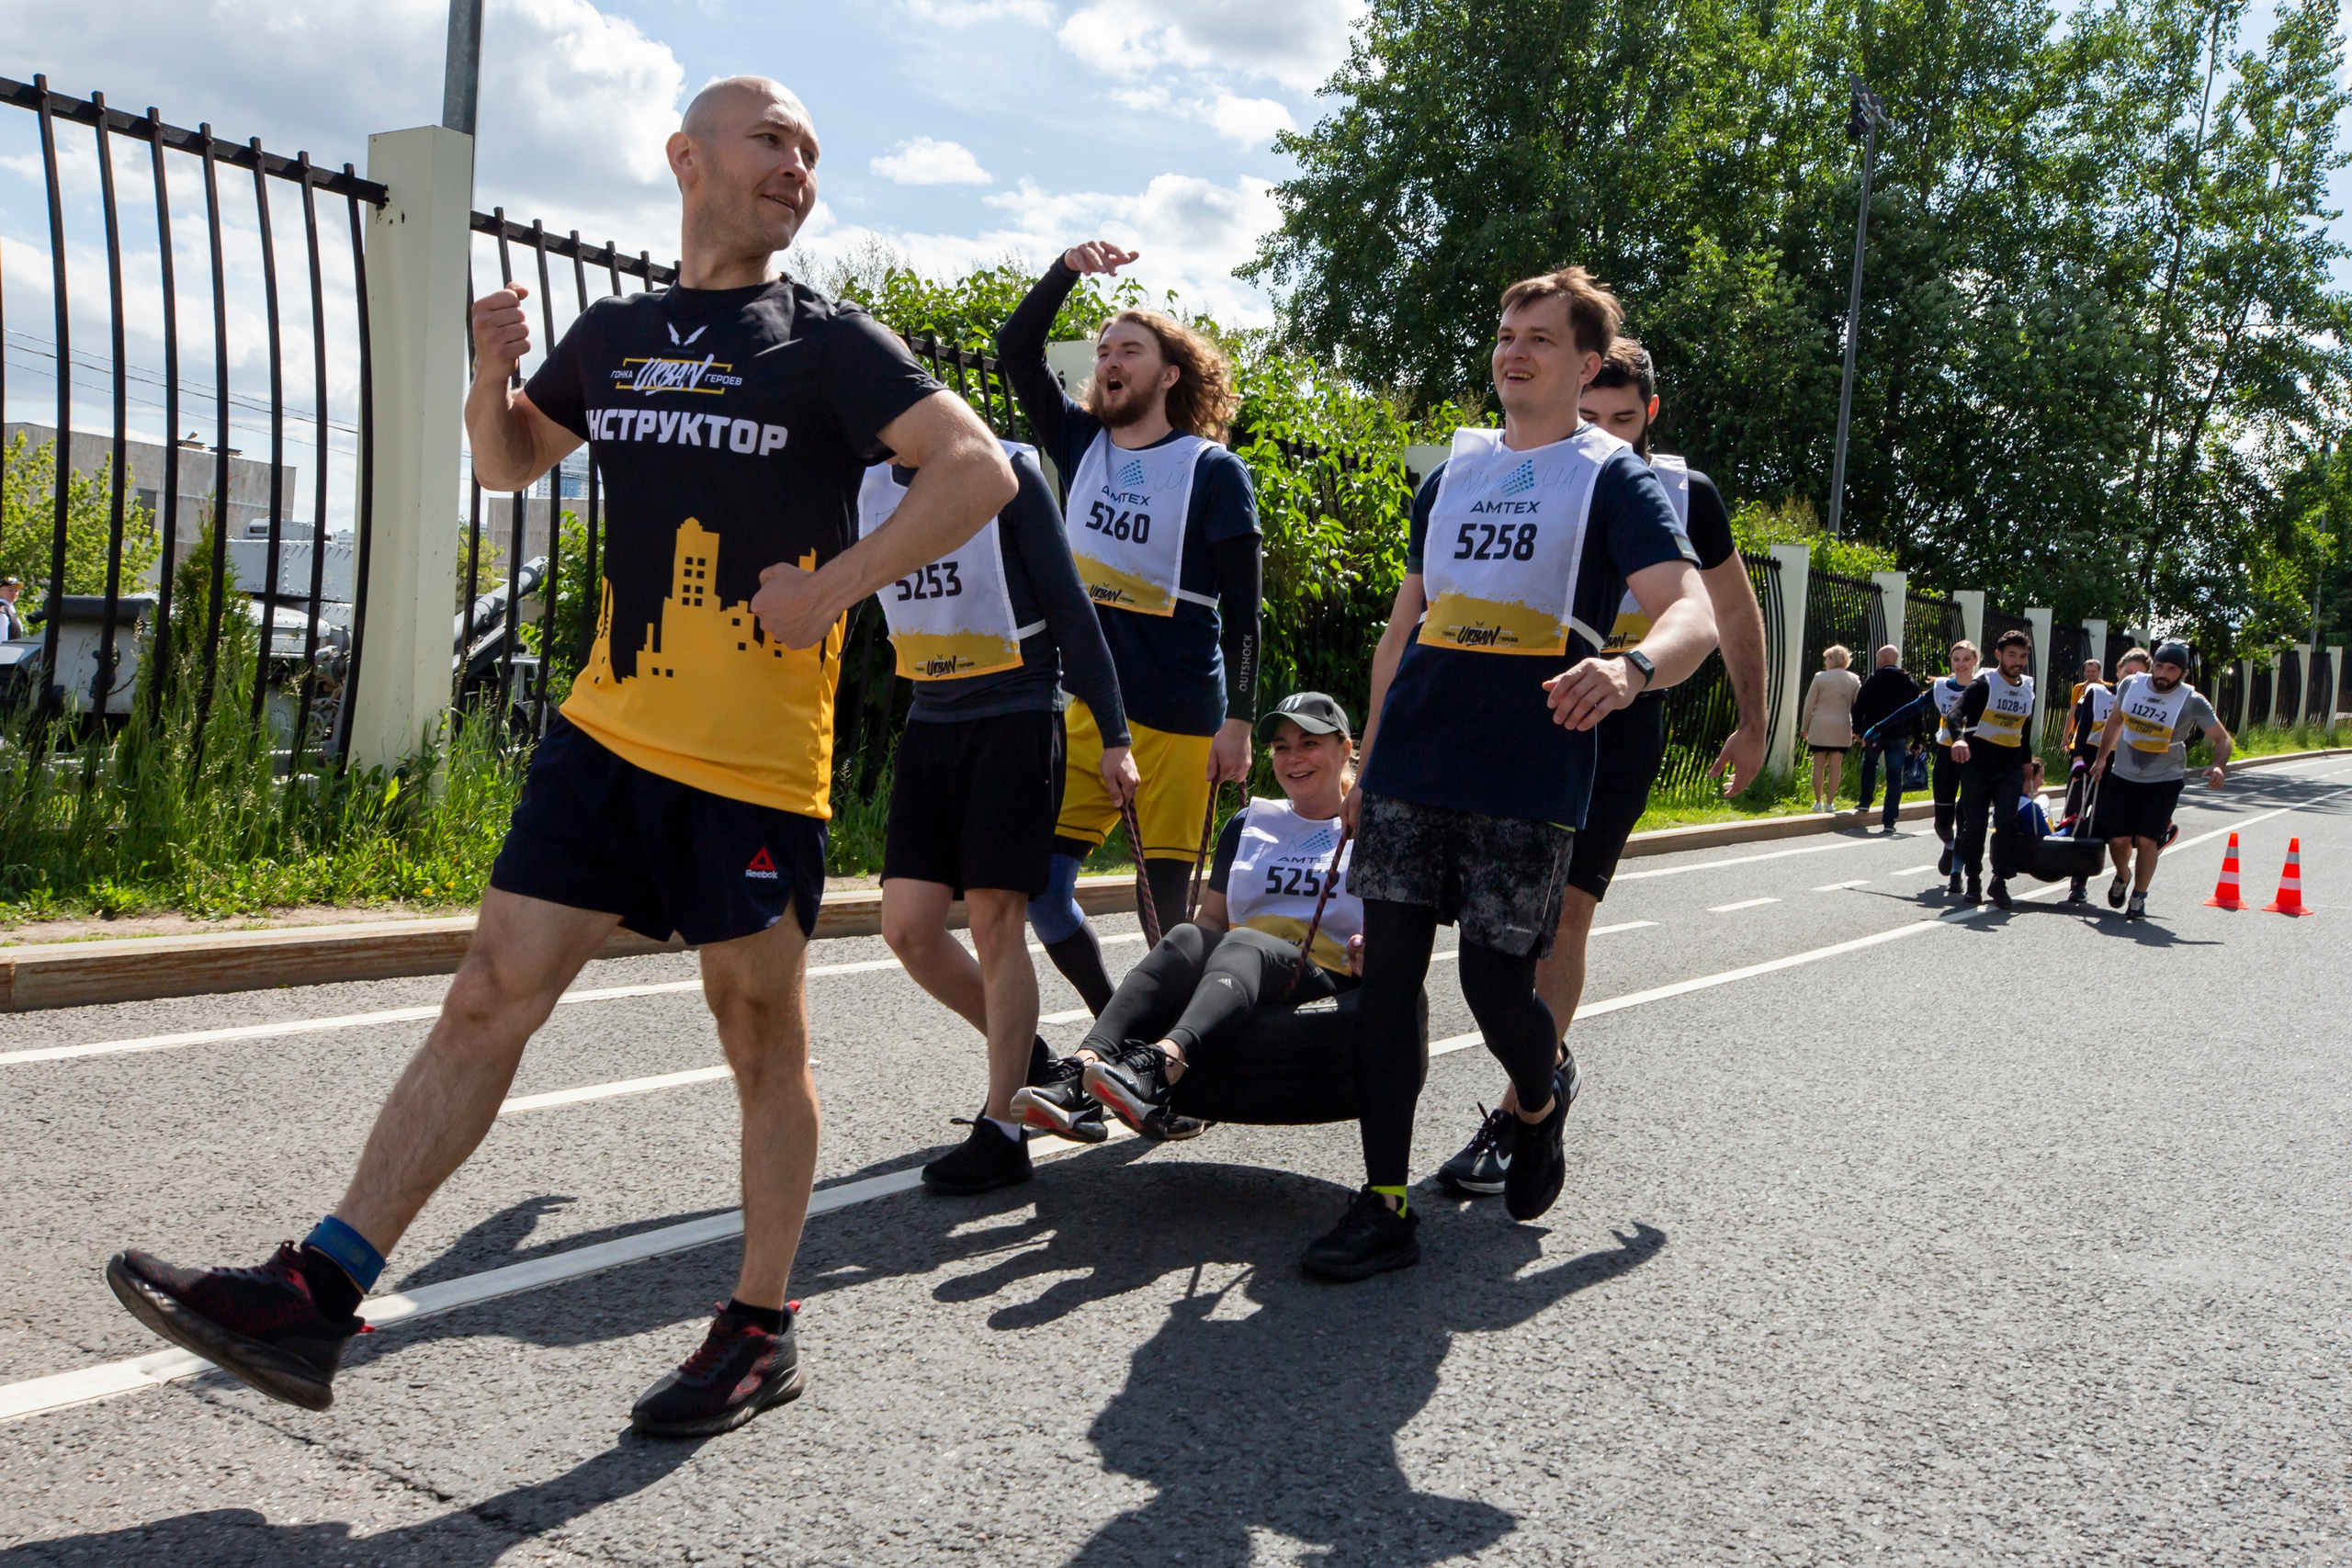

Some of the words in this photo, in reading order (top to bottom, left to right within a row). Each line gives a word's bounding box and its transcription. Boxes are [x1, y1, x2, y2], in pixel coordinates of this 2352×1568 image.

[610, 369, 633, 379] ГОНКА
[633, 353, 715, 396] URBAN
[704, 373, 742, 386] ГЕРОЕВ
[586, 409, 788, 457] НСТРУКТОР
[1102, 484, 1151, 506] AMTEX
[1470, 501, 1541, 514] AMTEX
[1085, 500, 1151, 545] 5260
[1453, 523, 1538, 561] 5258
[1457, 626, 1501, 647] URBAN
[927, 655, 956, 677] URBAN
[1238, 634, 1253, 692] OUTSHOCK
[1996, 698, 2027, 714] 1028-1
[2131, 703, 2167, 723] 1127-2
[745, 869, 778, 879] Reebok
[1265, 865, 1340, 898] 5252
